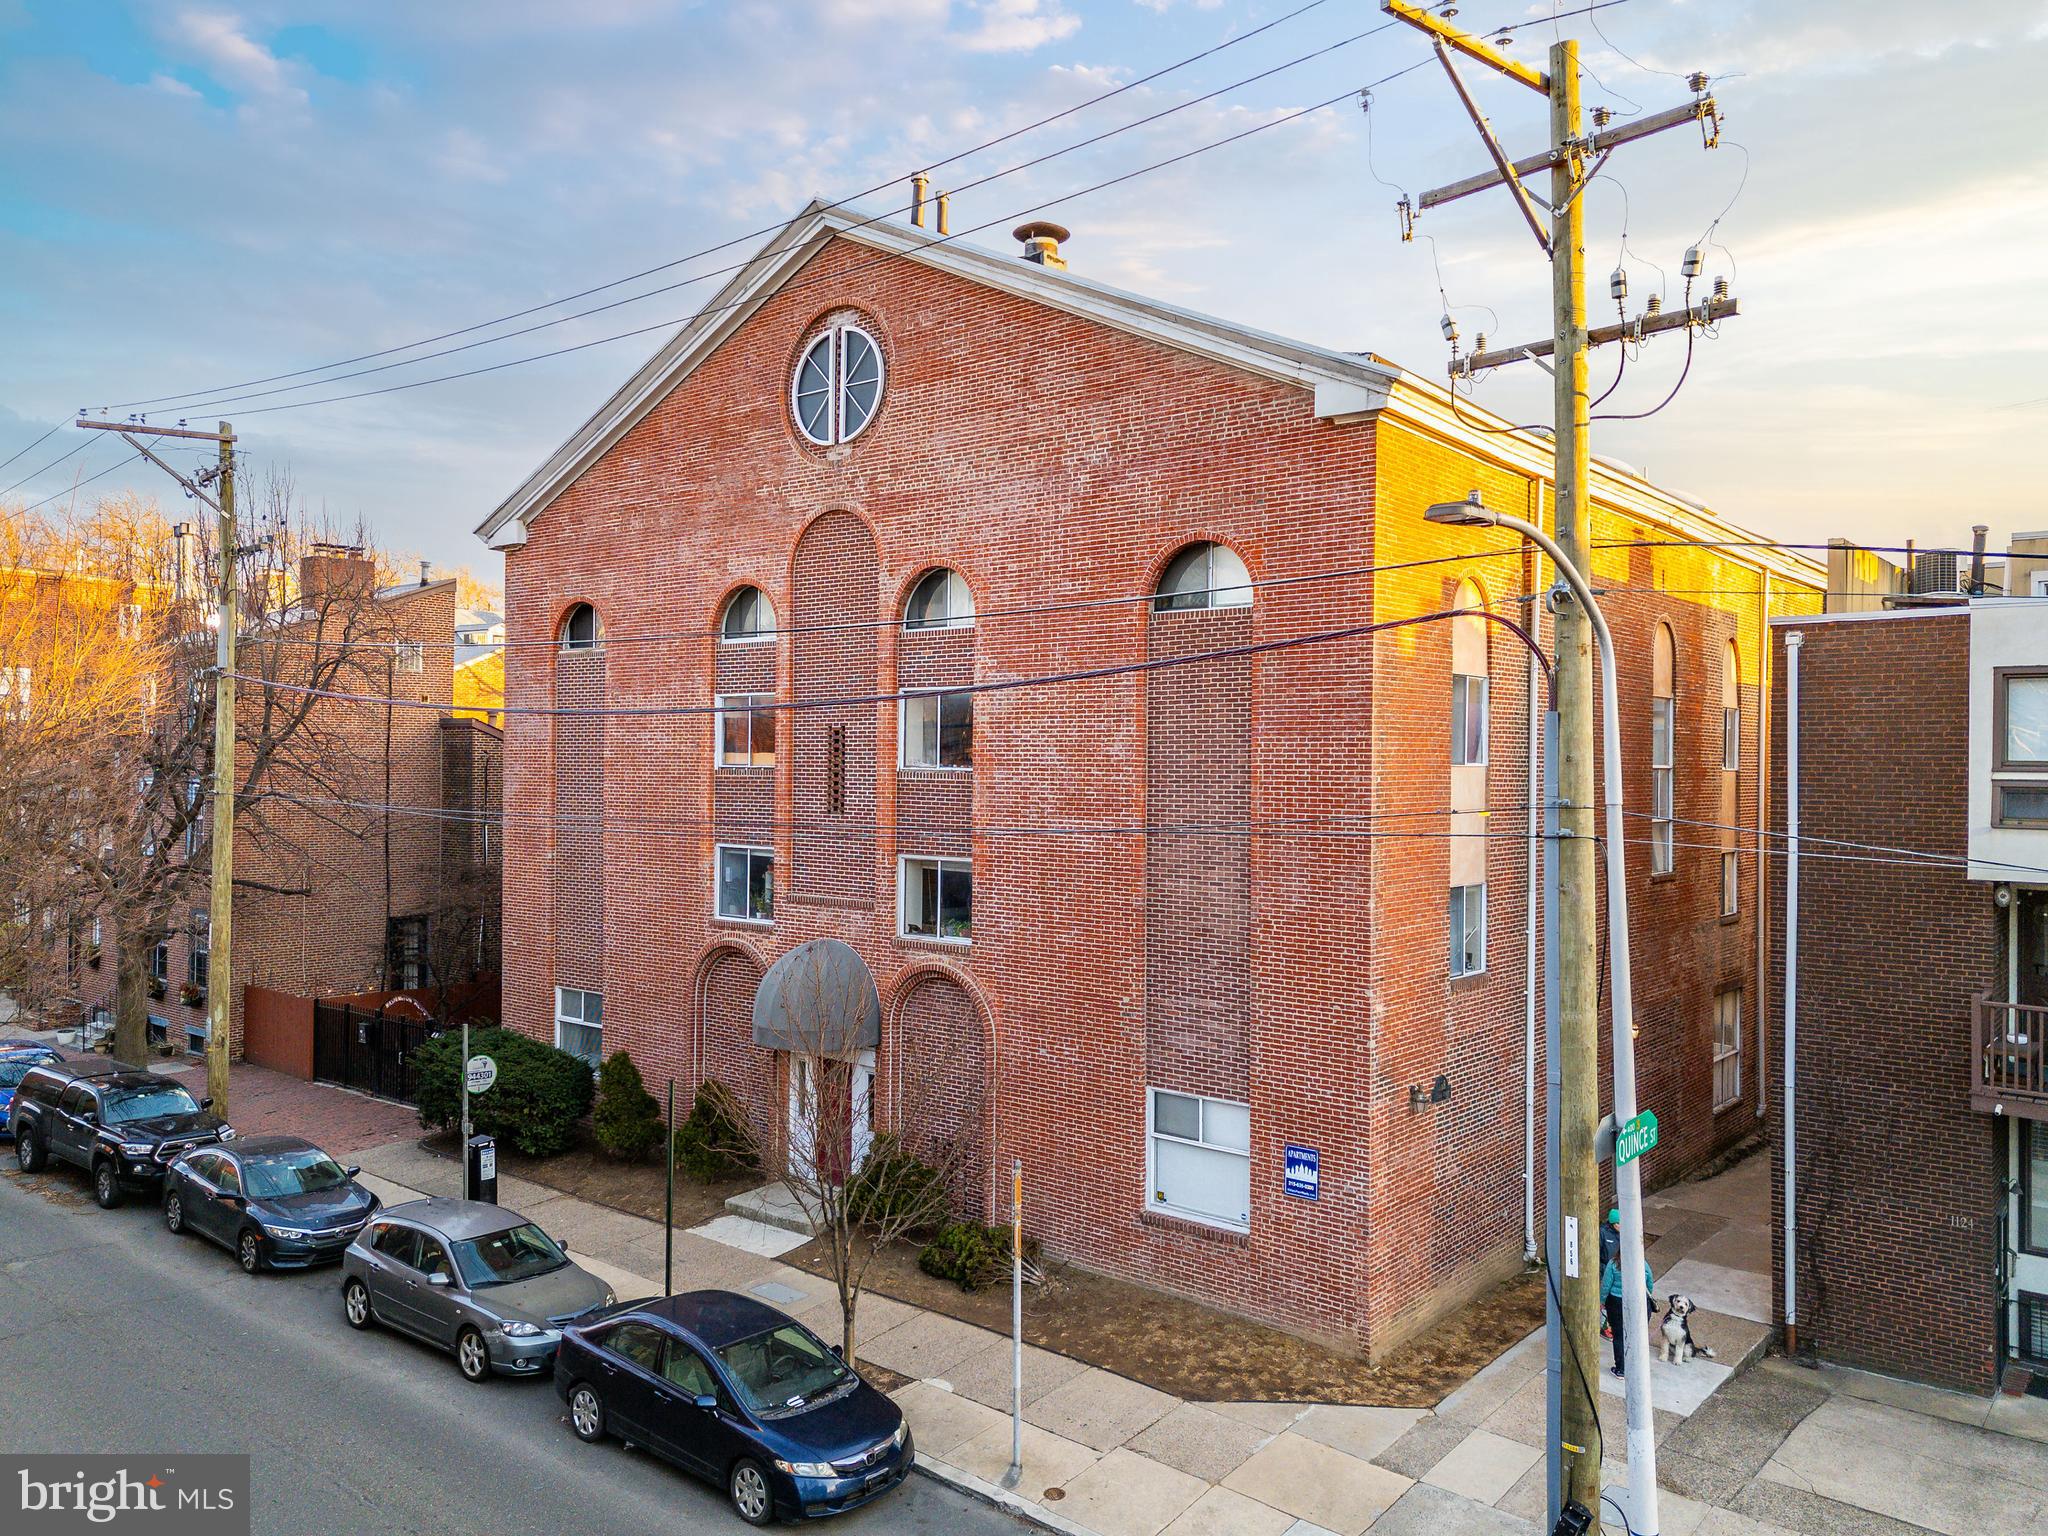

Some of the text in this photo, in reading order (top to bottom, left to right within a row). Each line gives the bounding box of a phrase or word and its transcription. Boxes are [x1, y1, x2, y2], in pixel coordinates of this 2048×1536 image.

[1618, 1126, 1656, 1163] QUINCE ST
[1288, 1150, 1317, 1163] APARTMENTS
[1951, 1215, 1974, 1231] 1124
